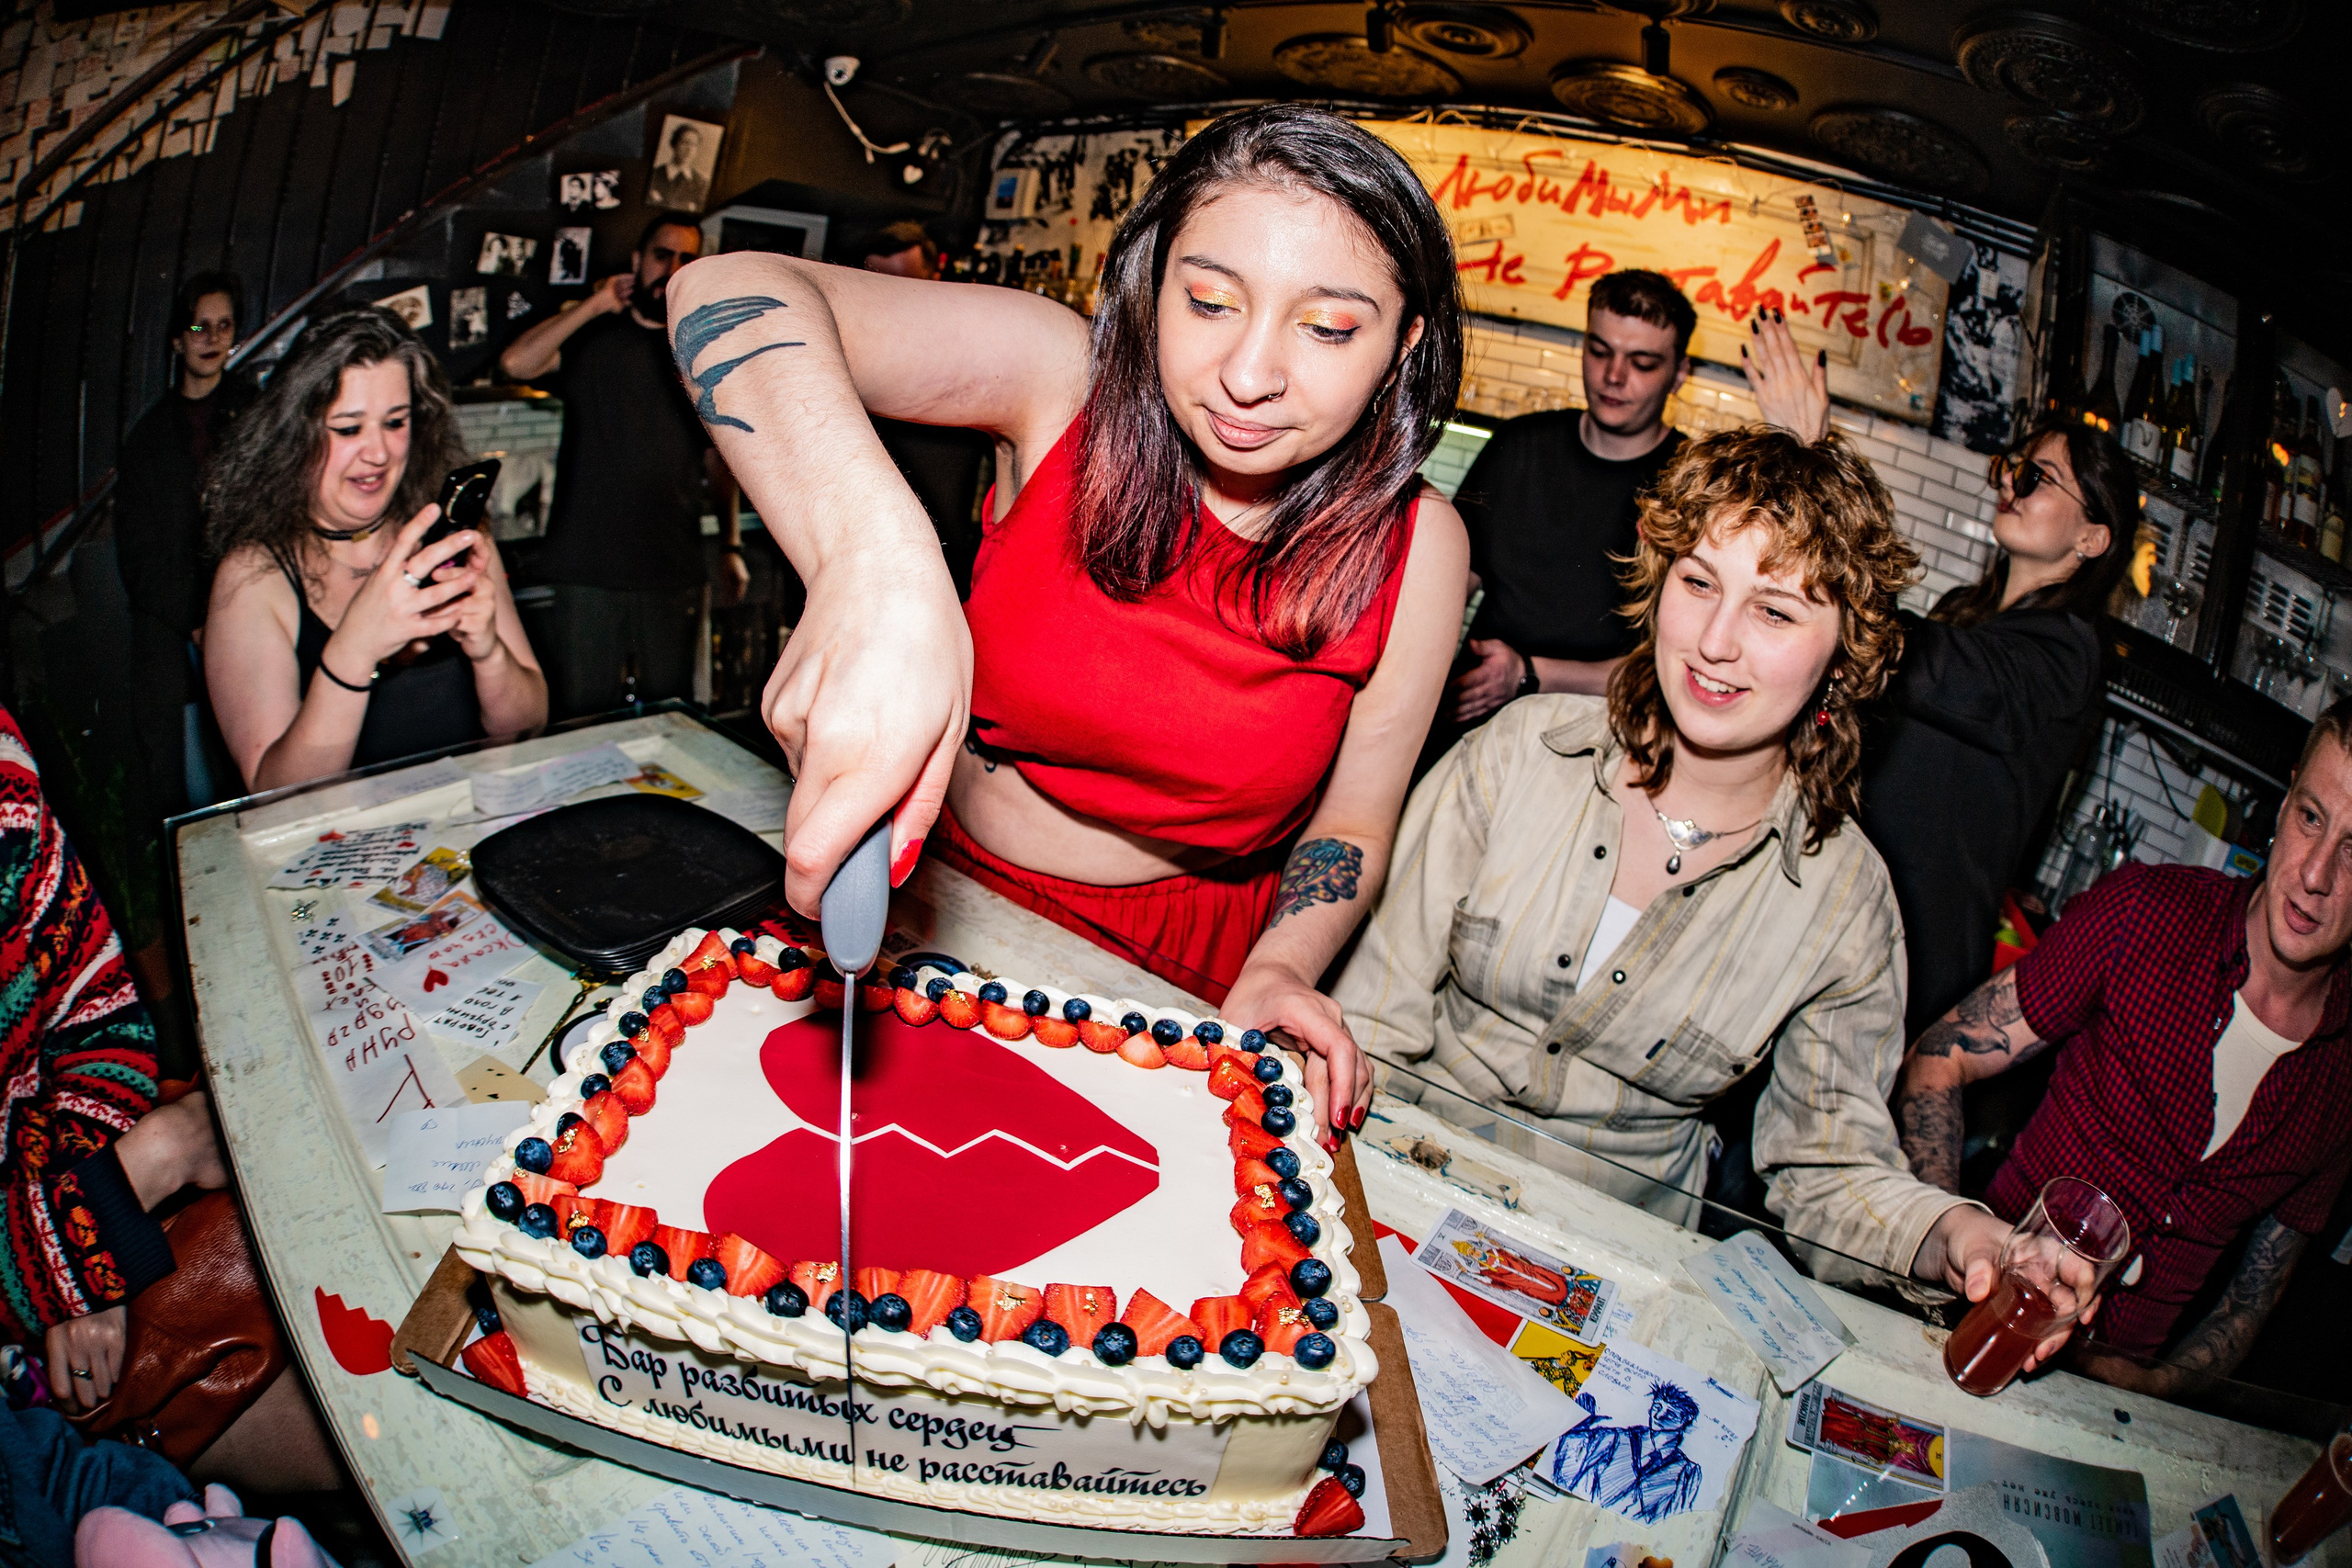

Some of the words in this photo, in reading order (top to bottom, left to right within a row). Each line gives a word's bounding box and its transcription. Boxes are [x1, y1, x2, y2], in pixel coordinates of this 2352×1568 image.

[581, 1324, 667, 1390] Бар
[684, 1364, 878, 1426] разбитых
[888, 1405, 1062, 1451] сердец
[598, 1375, 632, 1410] С
[642, 1398, 854, 1467] любимыми
[867, 1445, 910, 1472] не
[918, 1454, 1208, 1498] расставайтесь
[2001, 1480, 2024, 1492] нет
[2033, 1489, 2055, 1499] уже
[2002, 1493, 2080, 1527] МОВСИСЯН
